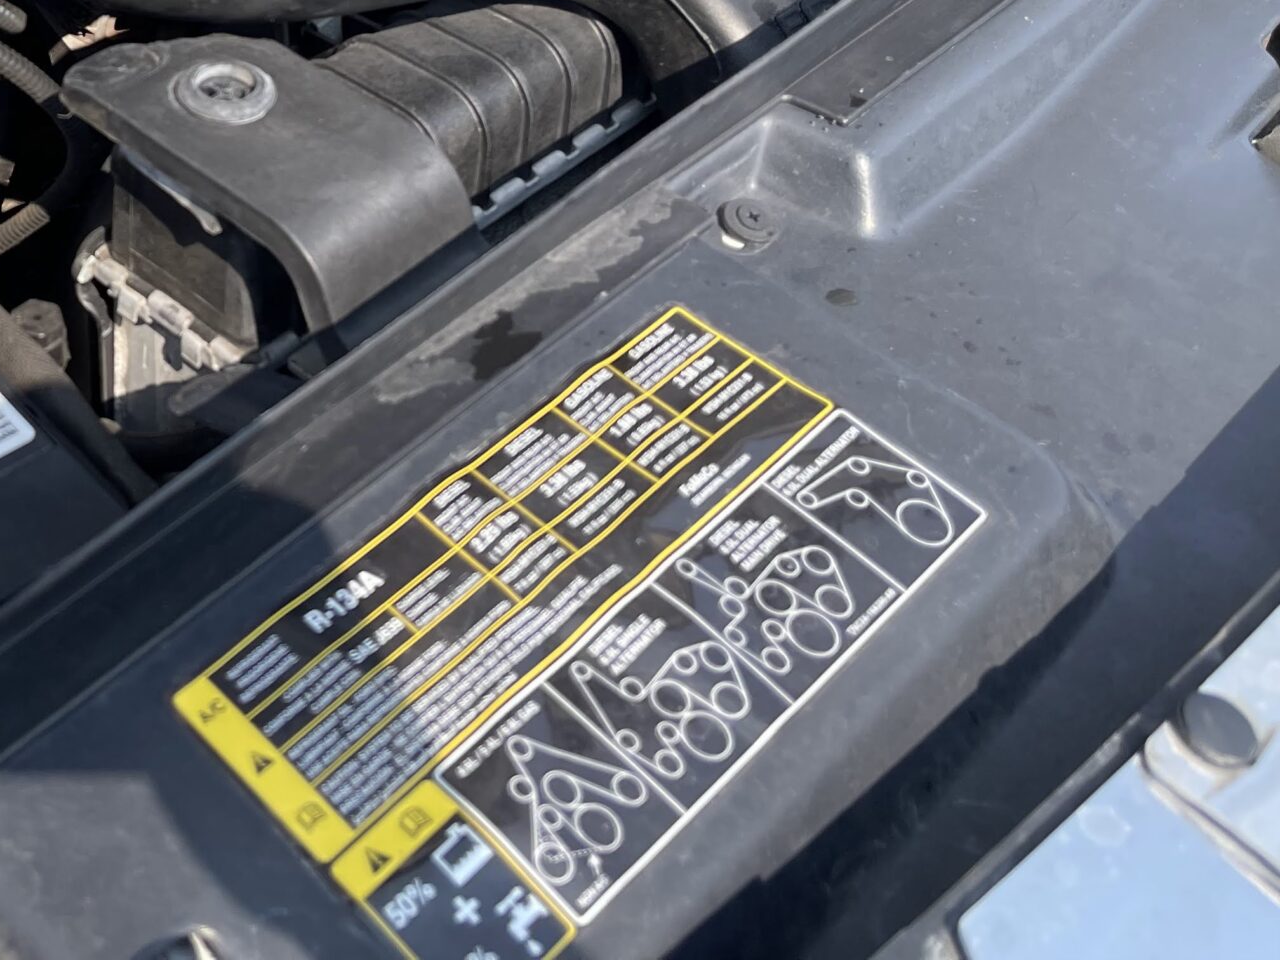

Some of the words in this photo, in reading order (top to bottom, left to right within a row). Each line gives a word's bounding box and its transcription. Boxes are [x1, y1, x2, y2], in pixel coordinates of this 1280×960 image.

[625, 321, 677, 361] GASOLINE
[558, 367, 616, 411] GASOLINE
[501, 423, 546, 458] DIESEL
[794, 461, 820, 484] DUAL
[811, 424, 861, 468] ALTERNATOR
[674, 459, 723, 500] FoMoCo
[769, 462, 803, 490] DIESEL
[705, 517, 741, 548] DIESEL
[726, 514, 782, 564] ALTERNATOR
[731, 516, 761, 542] DUAL
[757, 527, 789, 554] DRIVE
[303, 568, 386, 634] R-134A
[584, 620, 625, 658] DIESEL
[604, 616, 671, 677] ALTERNATOR
[612, 612, 652, 648] SINGLE
[345, 635, 381, 666] SAE
[195, 695, 228, 725] A/C
[381, 876, 438, 931] 50%
